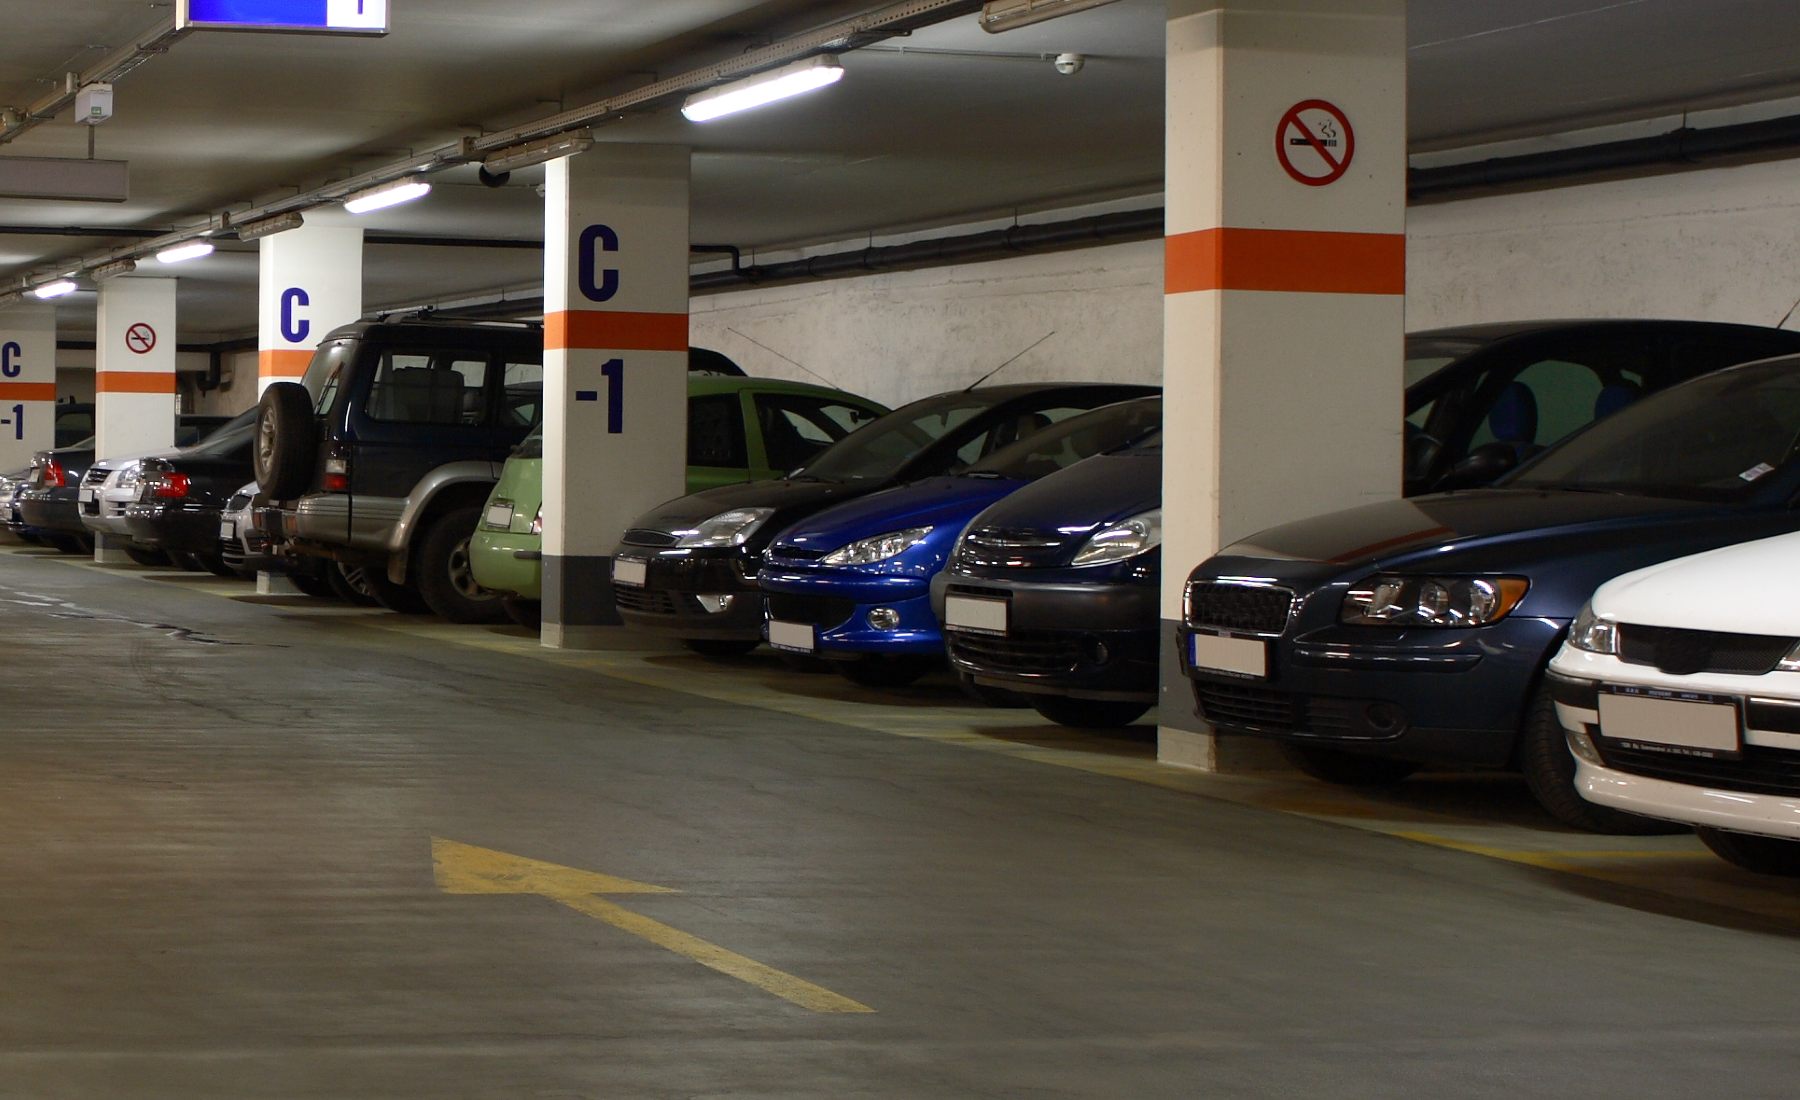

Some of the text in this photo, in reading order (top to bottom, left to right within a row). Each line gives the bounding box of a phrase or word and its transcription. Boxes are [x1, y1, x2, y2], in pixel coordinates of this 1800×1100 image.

[578, 224, 619, 302] C
[280, 287, 310, 343] C
[2, 341, 21, 377] C
[1, 404, 23, 440] -1
[575, 358, 624, 434] -1
